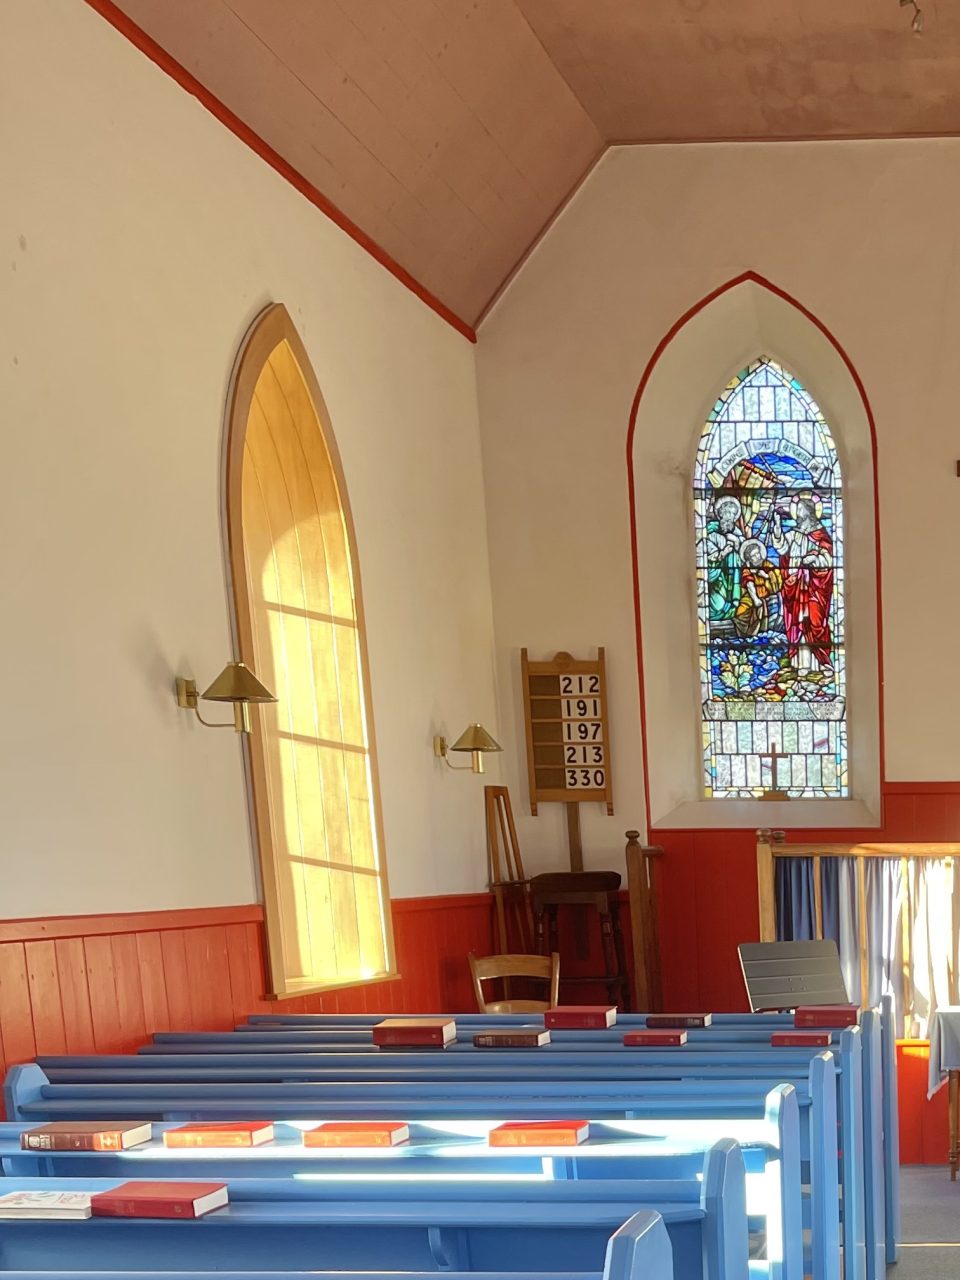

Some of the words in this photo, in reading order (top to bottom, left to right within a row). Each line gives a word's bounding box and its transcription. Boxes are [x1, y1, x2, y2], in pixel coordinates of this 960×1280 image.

[562, 676, 600, 694] 212
[566, 699, 598, 717] 191
[566, 723, 601, 740] 197
[566, 746, 603, 763] 213
[567, 769, 604, 787] 330
